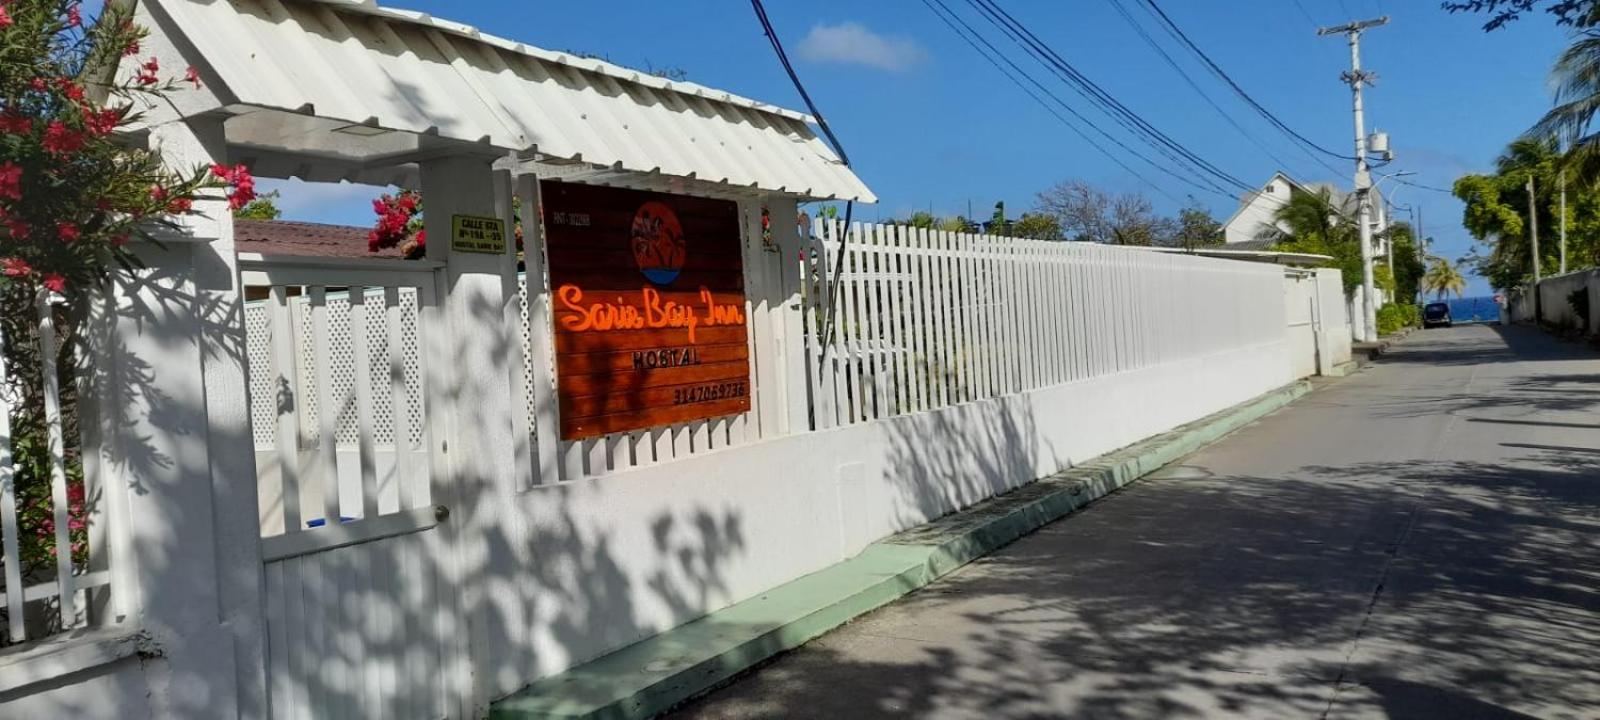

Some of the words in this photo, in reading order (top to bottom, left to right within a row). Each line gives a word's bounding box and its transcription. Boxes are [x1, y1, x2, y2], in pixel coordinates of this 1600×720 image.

[462, 219, 483, 229] CALLE
[558, 284, 645, 331] Sarie
[642, 286, 698, 343] Bay
[700, 286, 744, 326] Inn
[632, 348, 701, 369] HOSTAL
